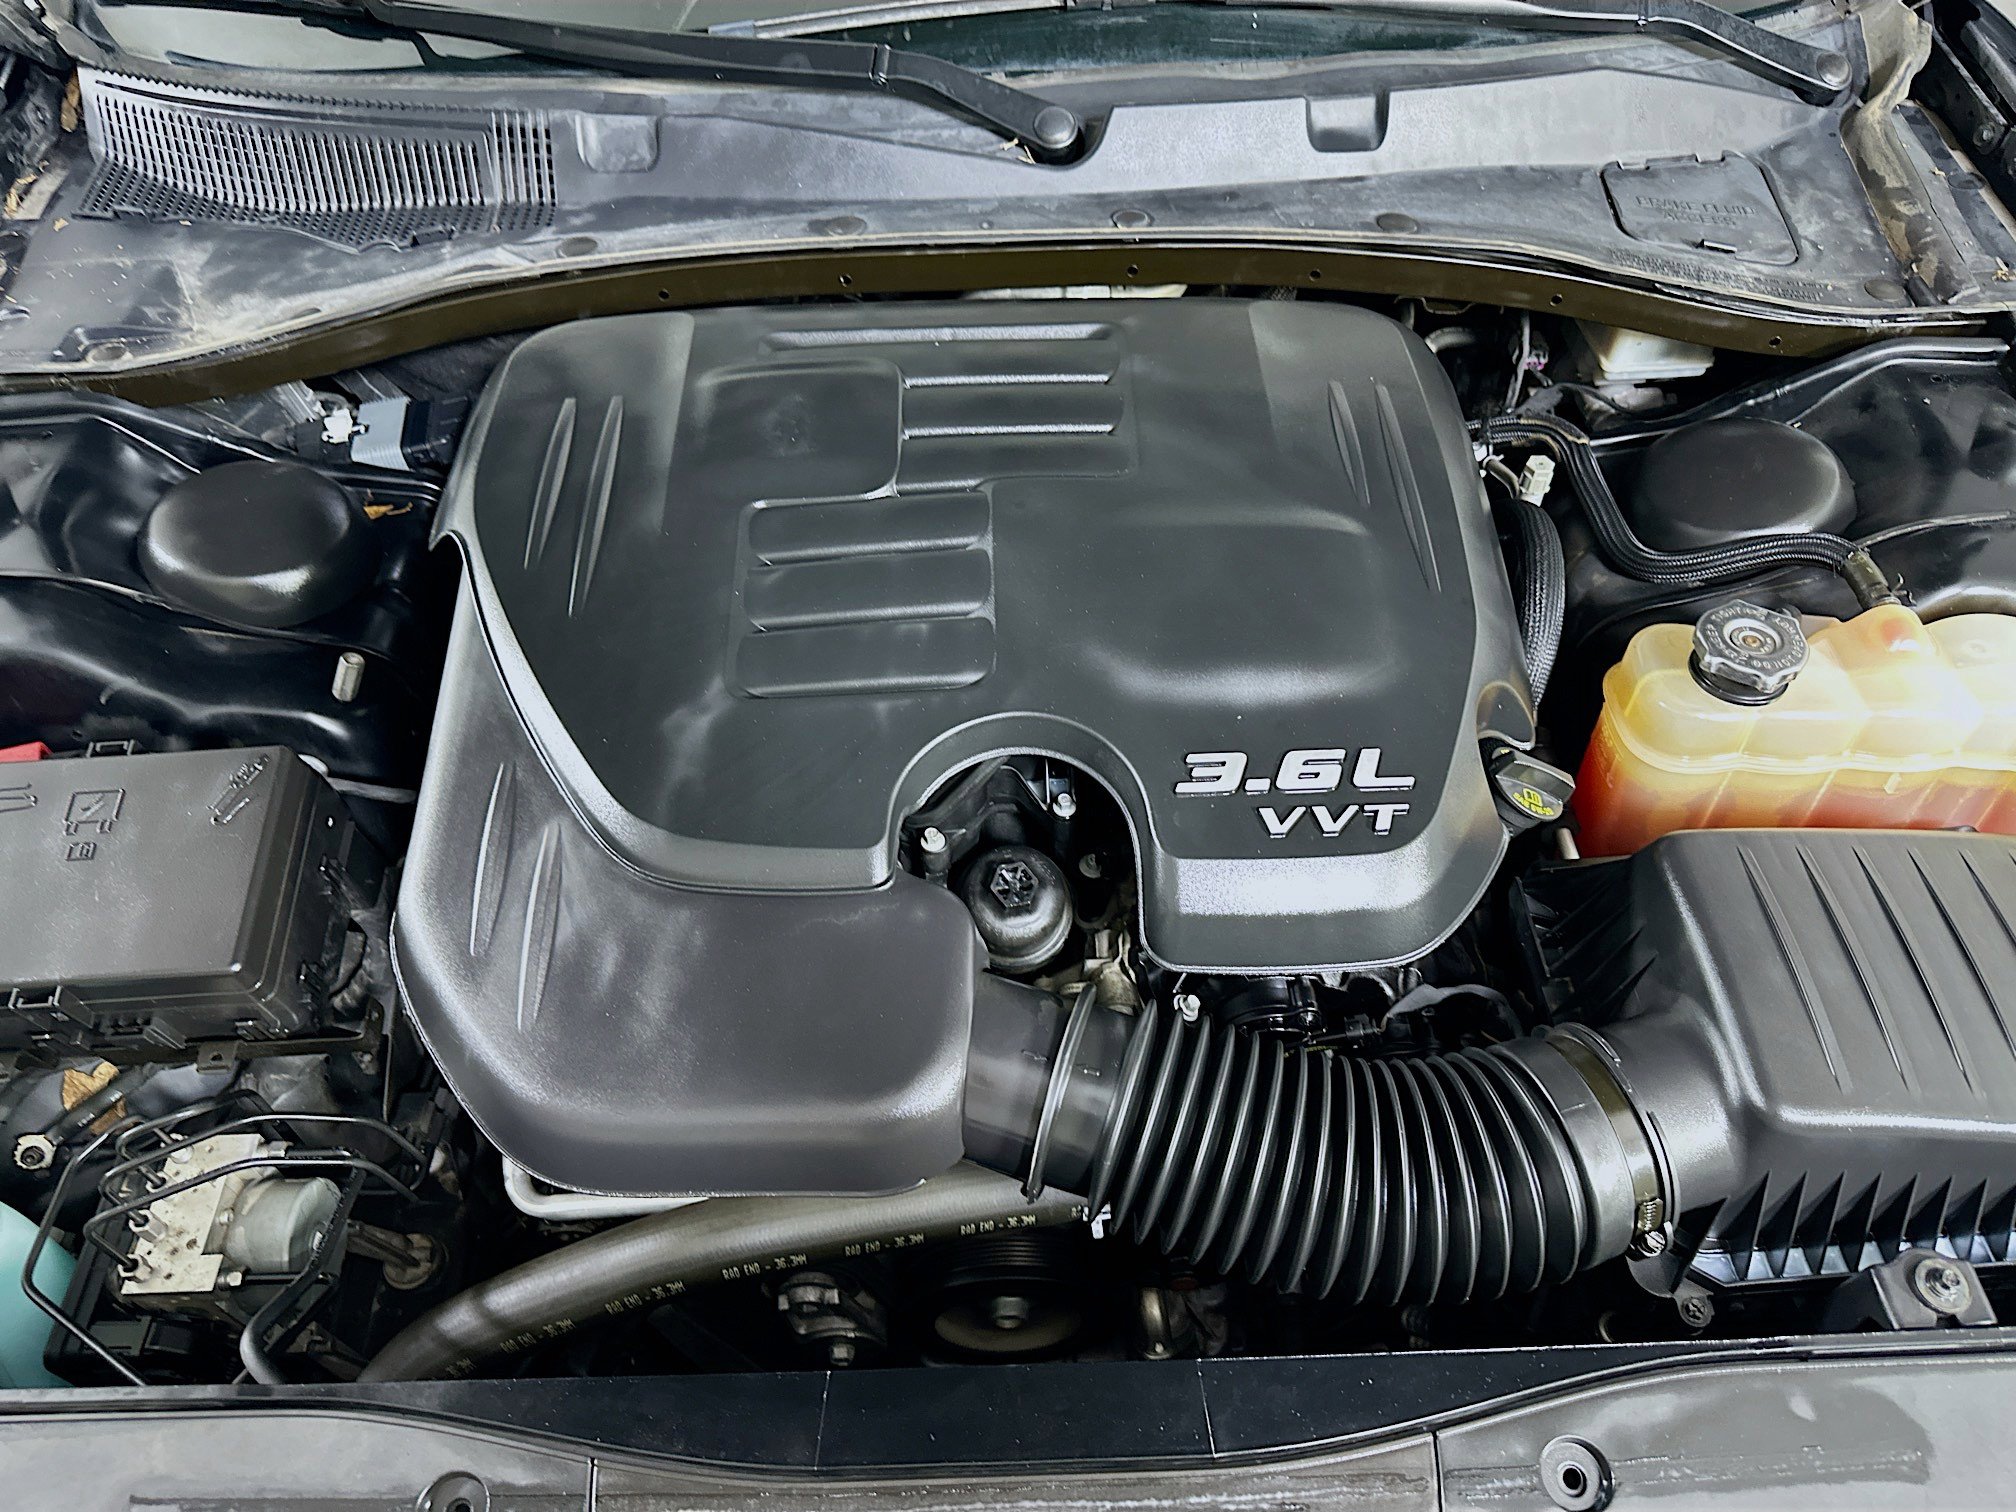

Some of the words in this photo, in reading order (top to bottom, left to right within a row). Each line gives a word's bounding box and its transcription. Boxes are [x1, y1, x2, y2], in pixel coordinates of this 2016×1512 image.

[1635, 196, 1695, 211] BRAKE
[1702, 203, 1756, 216] FLUID
[1664, 210, 1737, 226] ACCESS
[1174, 747, 1416, 796] 3.6L
[1257, 803, 1410, 839] VVT
[960, 1223, 976, 1237] RAD
[979, 1219, 995, 1233] END
[844, 1244, 862, 1258] RAD
[865, 1240, 881, 1254] END
[722, 1265, 740, 1281] RAD
[743, 1262, 761, 1276] END
[604, 1300, 624, 1317] RAD
[623, 1293, 643, 1309] END
